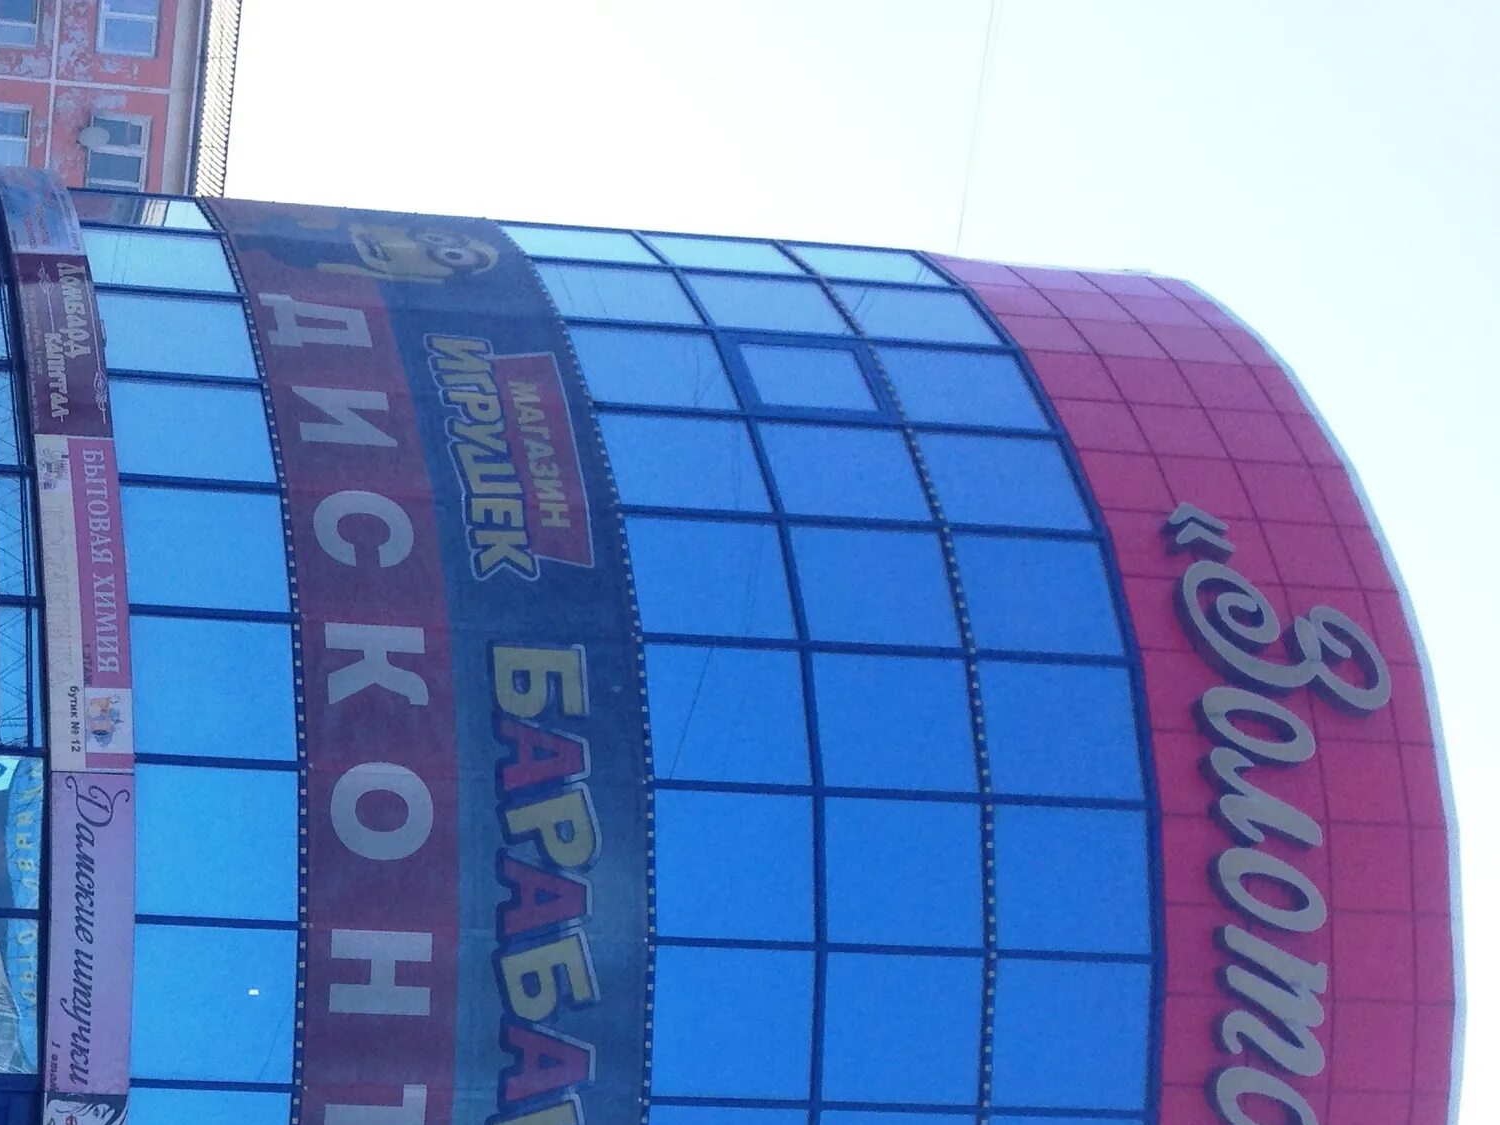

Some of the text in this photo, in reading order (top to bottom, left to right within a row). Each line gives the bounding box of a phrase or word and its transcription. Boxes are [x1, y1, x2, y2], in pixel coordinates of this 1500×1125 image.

[82, 448, 120, 674] БЫТОВАЯ ХИМИЯ
[427, 337, 533, 578] ИГРУШЕК
[507, 380, 571, 529] МАГАЗИН
[68, 685, 81, 753] бутик № 12
[60, 775, 130, 1087] Дамские штучки
